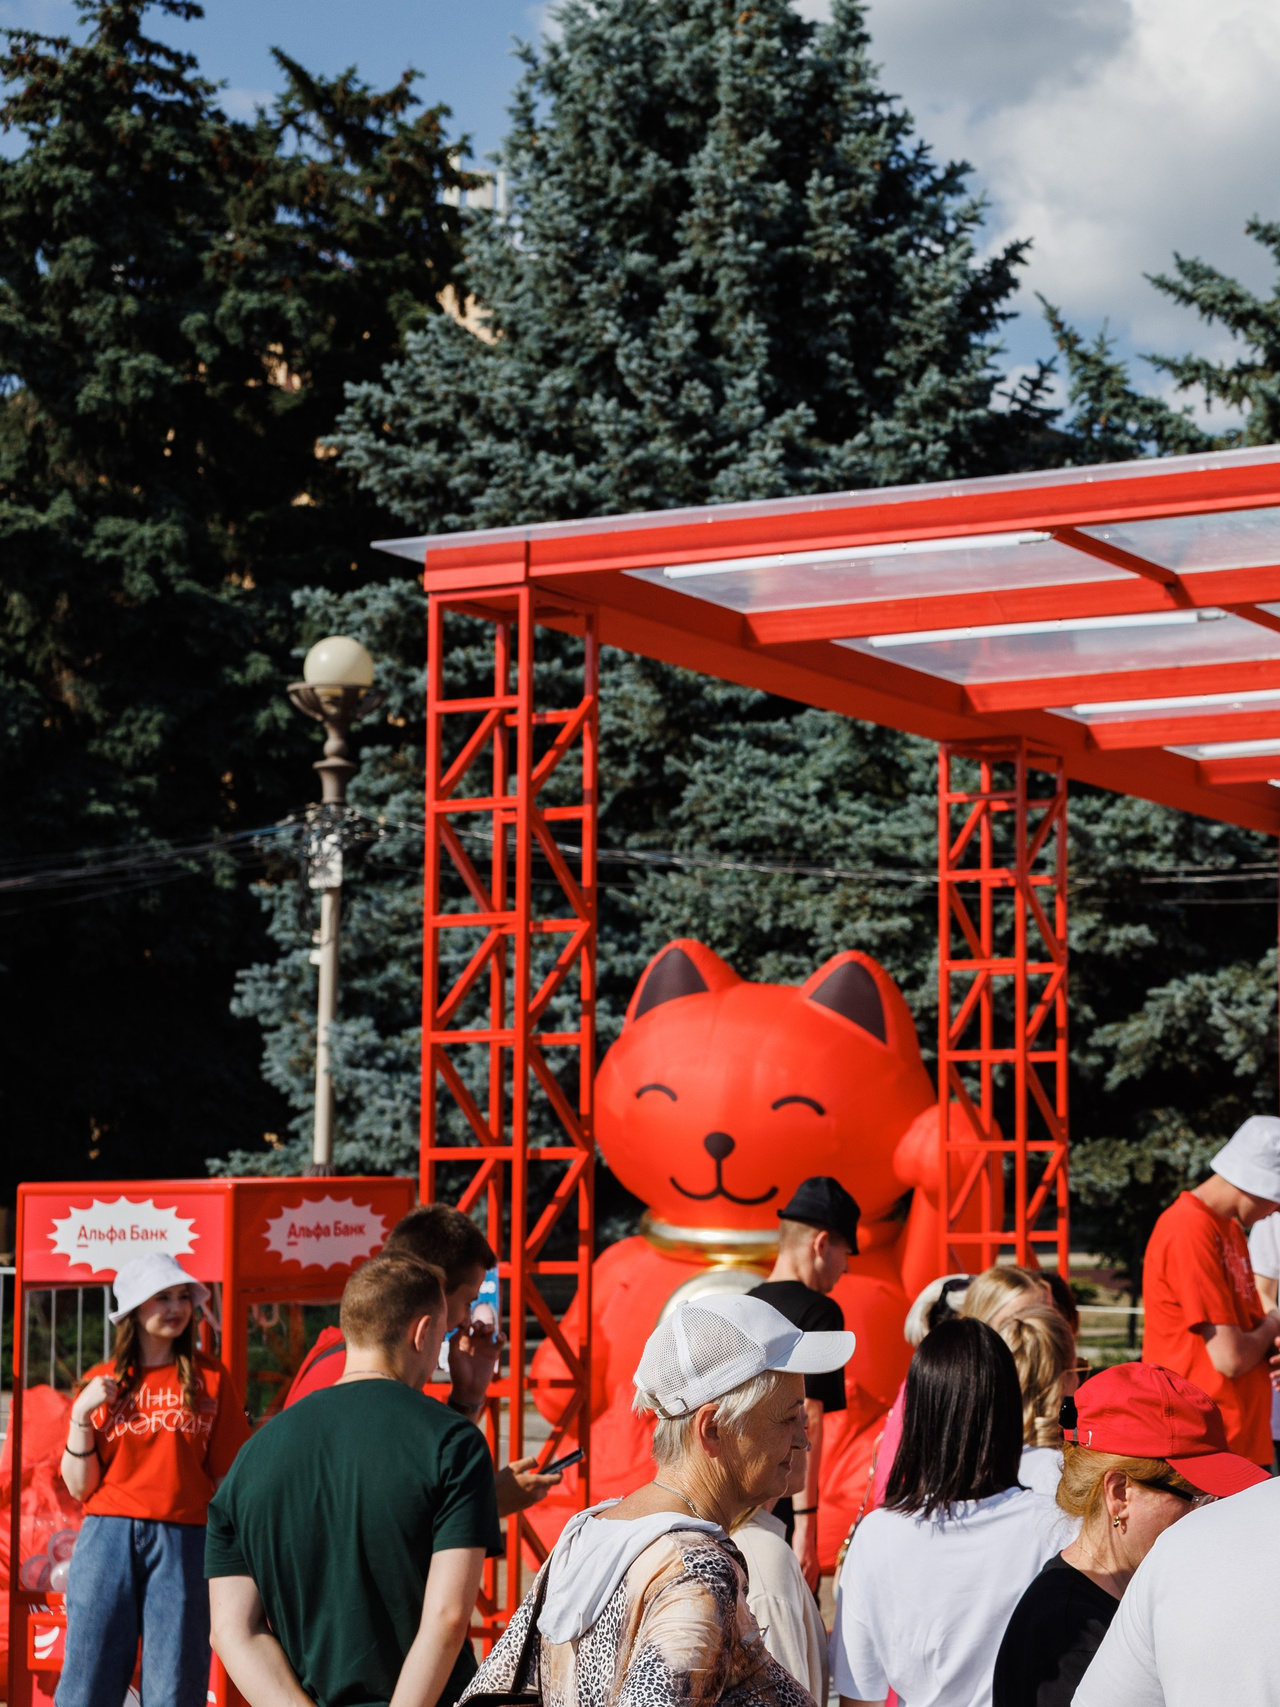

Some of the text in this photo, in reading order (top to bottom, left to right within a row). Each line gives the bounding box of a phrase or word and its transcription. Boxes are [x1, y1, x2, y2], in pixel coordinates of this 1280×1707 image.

[77, 1224, 168, 1244] Альфа Банк
[287, 1220, 366, 1242] Альфа Банк
